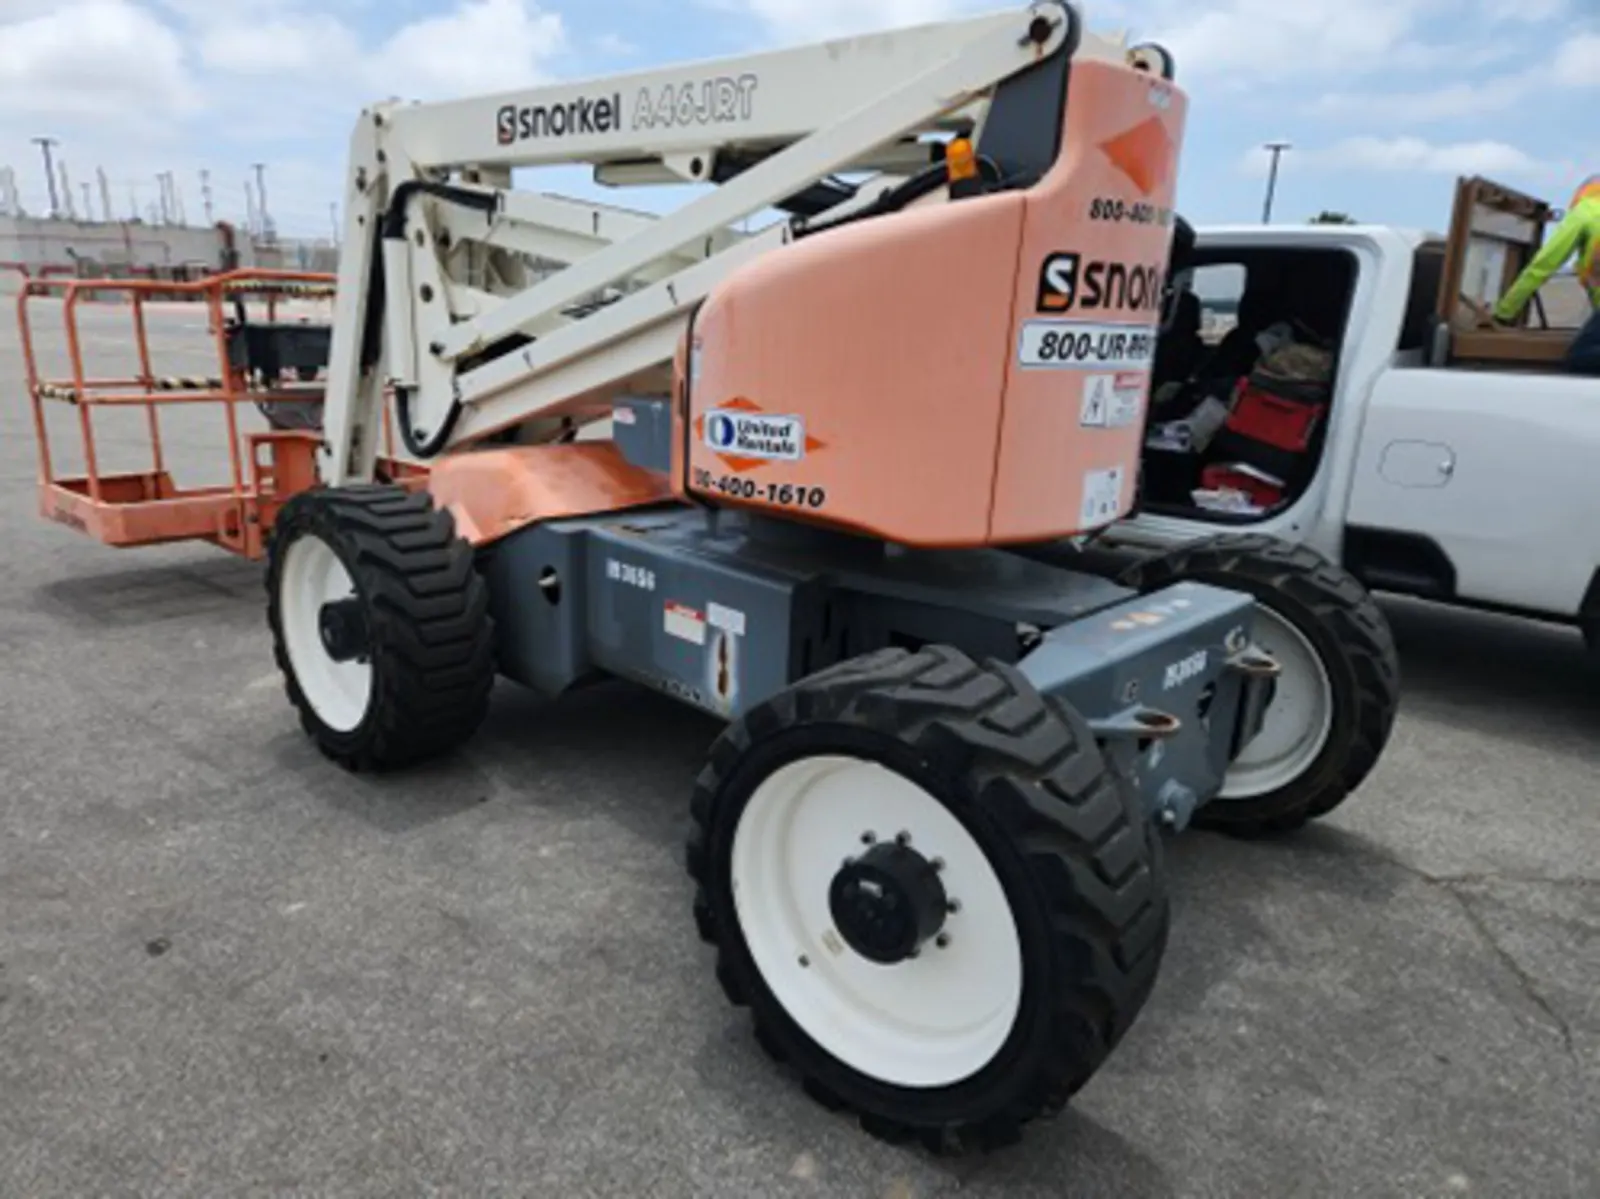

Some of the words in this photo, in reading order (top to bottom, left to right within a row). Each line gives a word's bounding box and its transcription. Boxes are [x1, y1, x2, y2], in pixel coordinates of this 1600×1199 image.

[519, 93, 621, 139] snorkel
[632, 74, 758, 128] A46JRT
[1080, 260, 1160, 312] snor
[737, 418, 792, 438] United
[737, 435, 797, 454] Rentals
